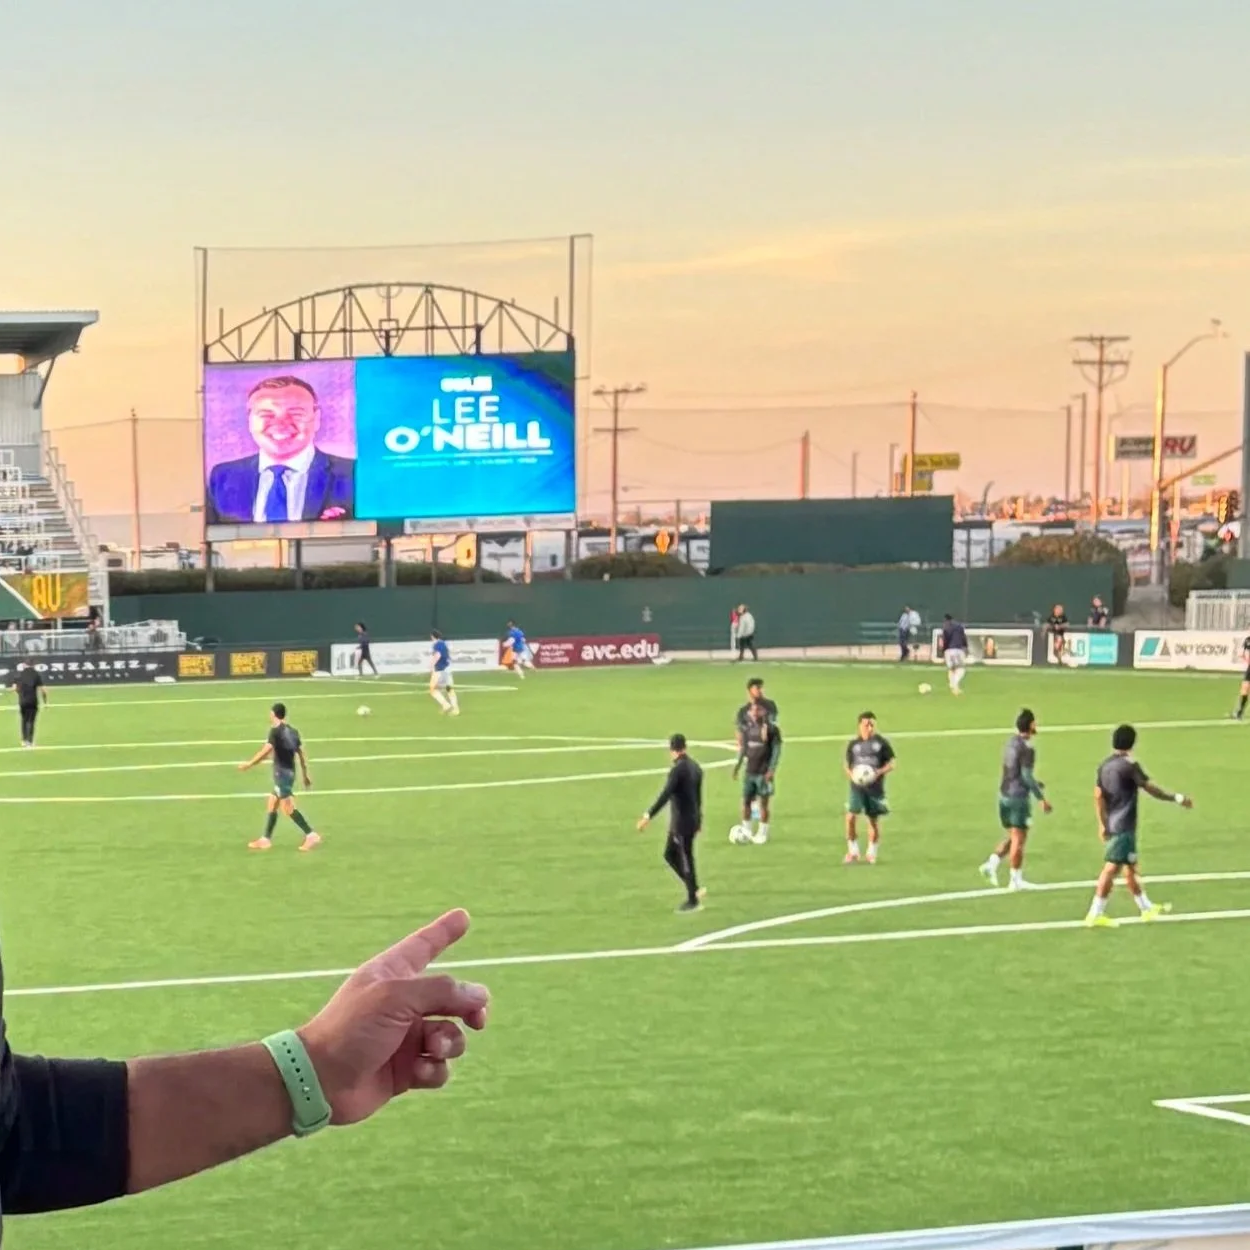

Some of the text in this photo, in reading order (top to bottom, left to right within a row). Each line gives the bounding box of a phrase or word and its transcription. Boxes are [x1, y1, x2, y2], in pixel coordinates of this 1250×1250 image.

[432, 395, 500, 425] LEE
[384, 420, 551, 453] O'NEILL
[581, 638, 660, 661] avc.edu
